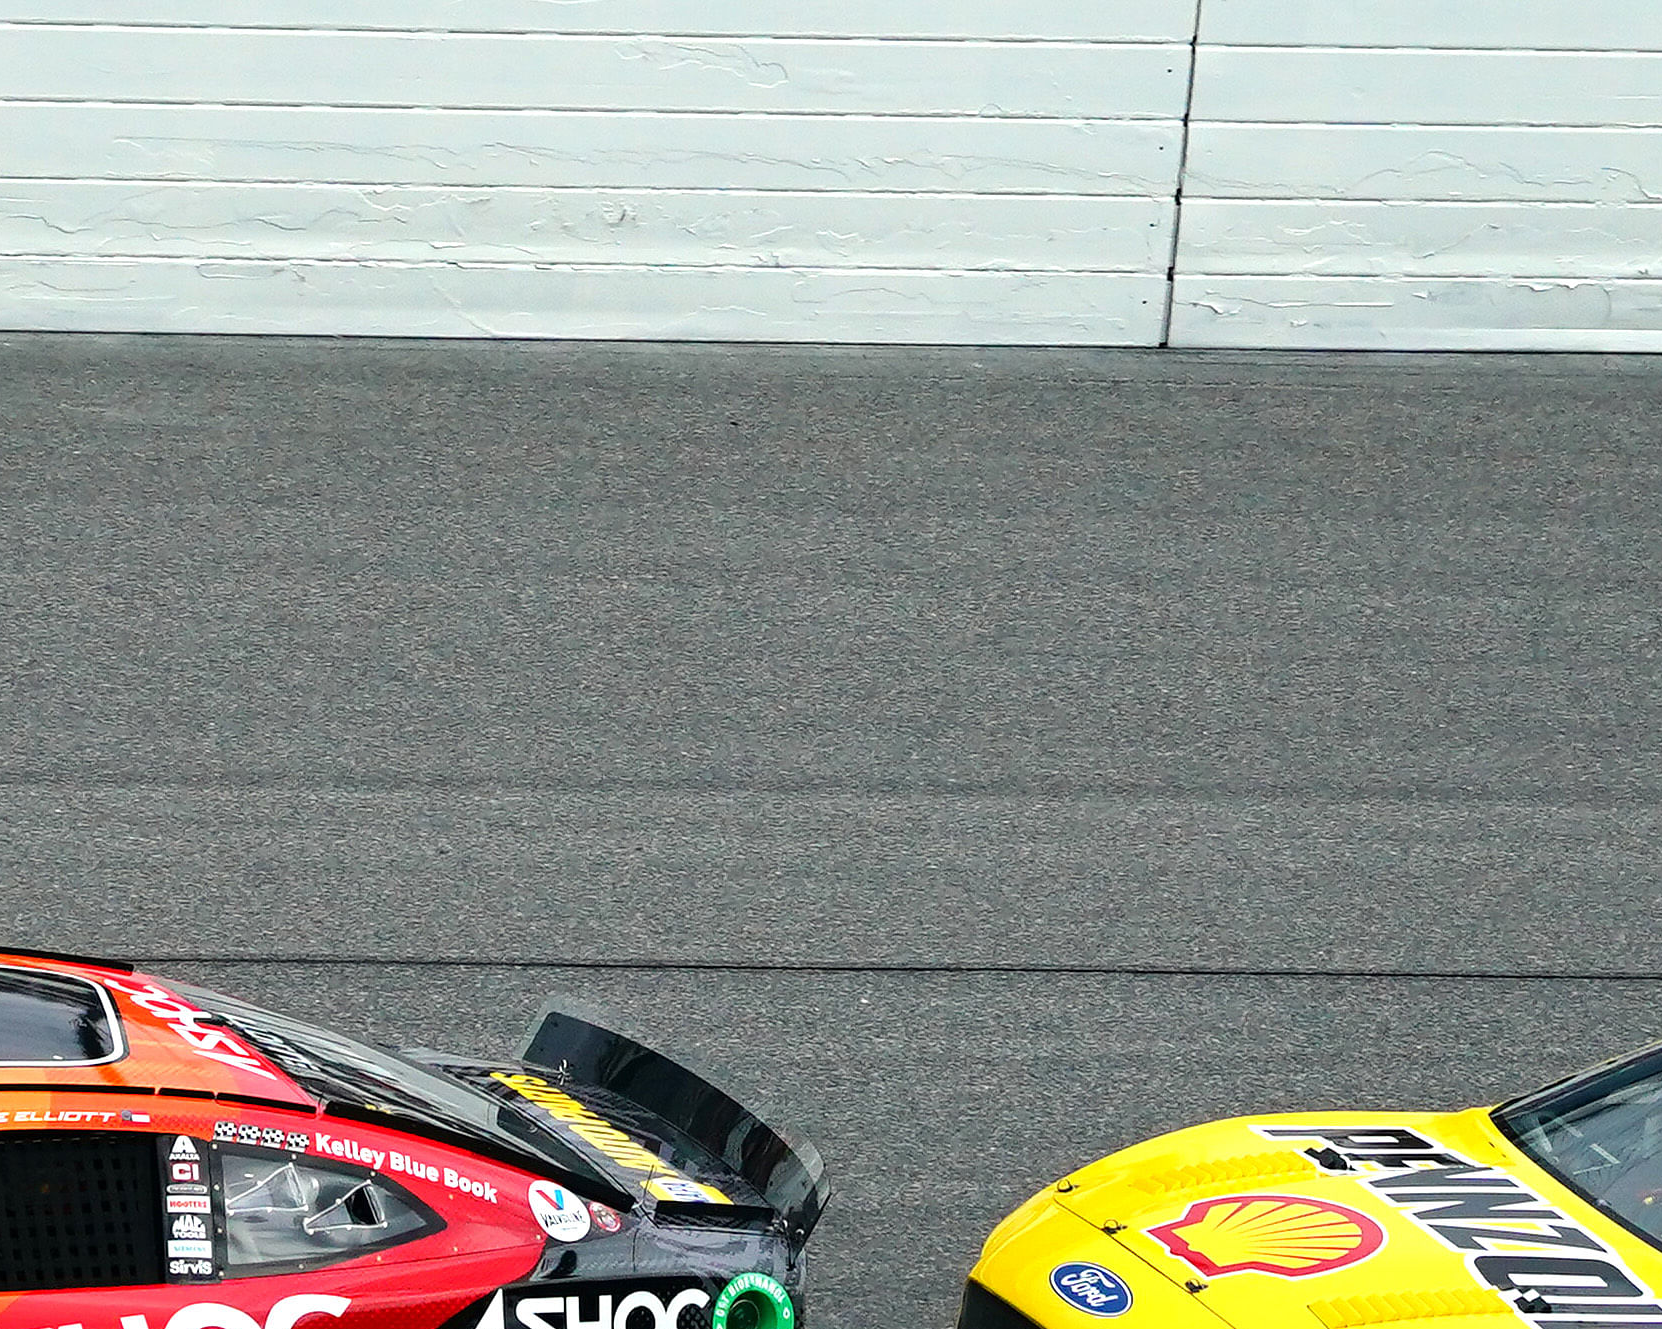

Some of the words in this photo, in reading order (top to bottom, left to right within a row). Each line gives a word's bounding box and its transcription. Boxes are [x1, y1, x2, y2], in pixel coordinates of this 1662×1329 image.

[13, 1110, 117, 1123] ELLIOTT
[315, 1132, 386, 1170] Kelley
[389, 1151, 440, 1183] Blue
[443, 1168, 498, 1205] Book
[1059, 1267, 1120, 1308] Ford
